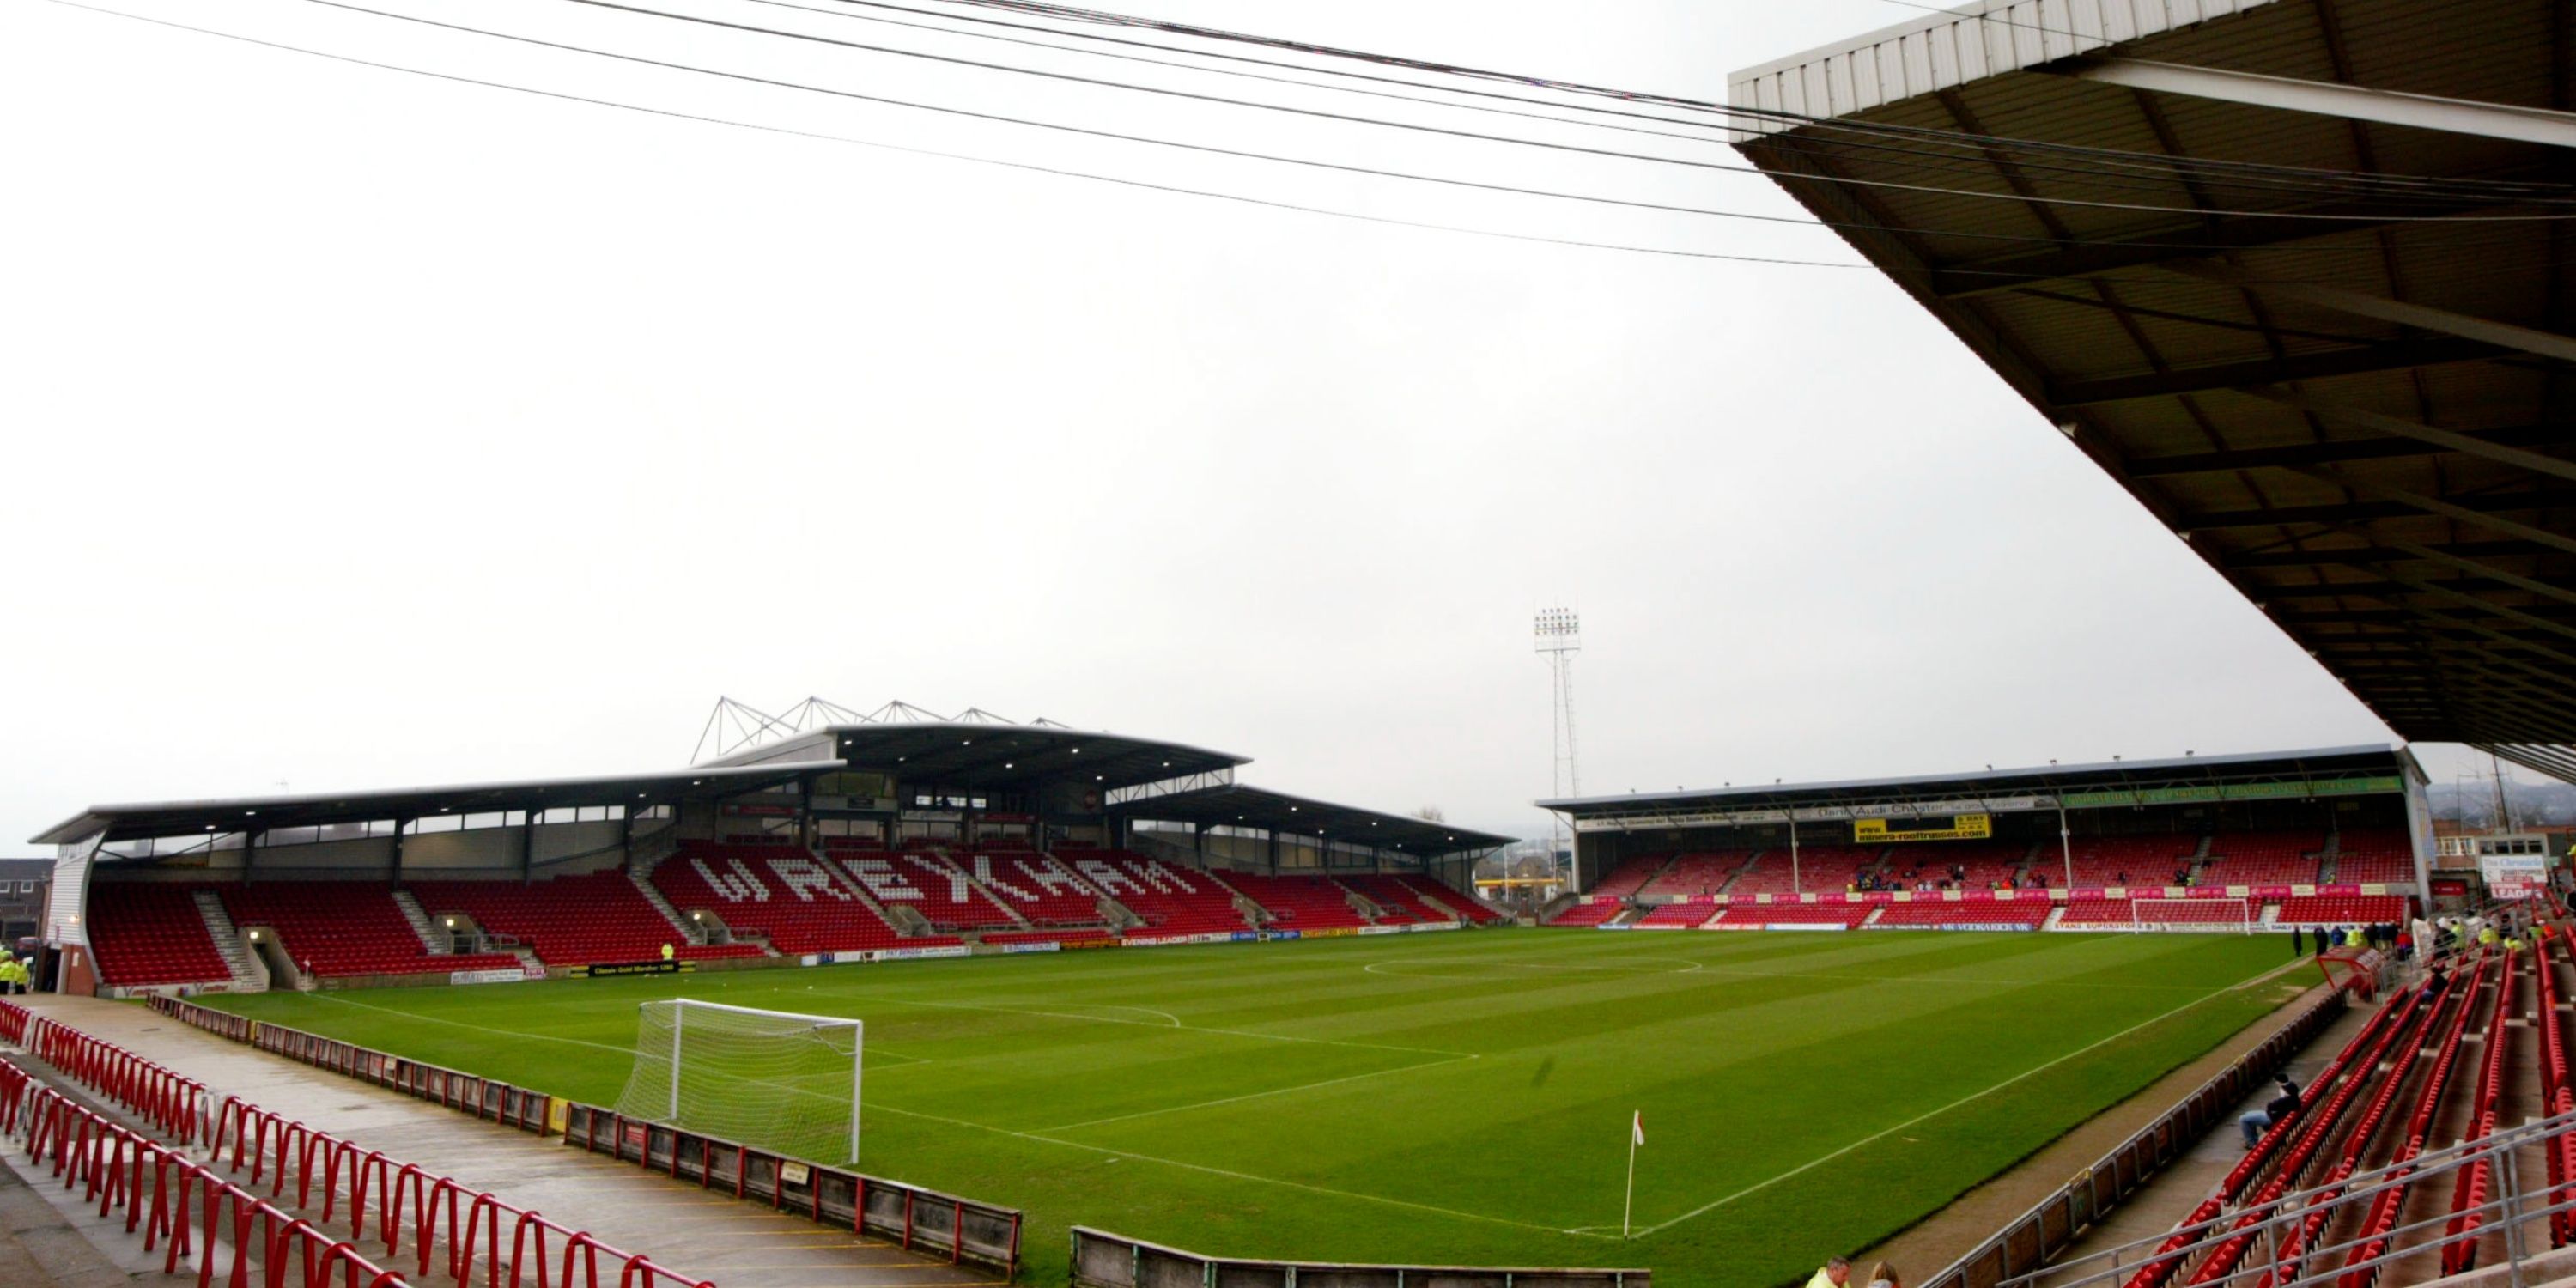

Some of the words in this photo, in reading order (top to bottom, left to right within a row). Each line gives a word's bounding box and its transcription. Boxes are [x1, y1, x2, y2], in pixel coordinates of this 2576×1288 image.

[1856, 805, 1886, 817] Audi
[1891, 802, 1944, 815] Chester
[1121, 936, 1157, 946] EVENING
[1157, 934, 1188, 944] LEADER
